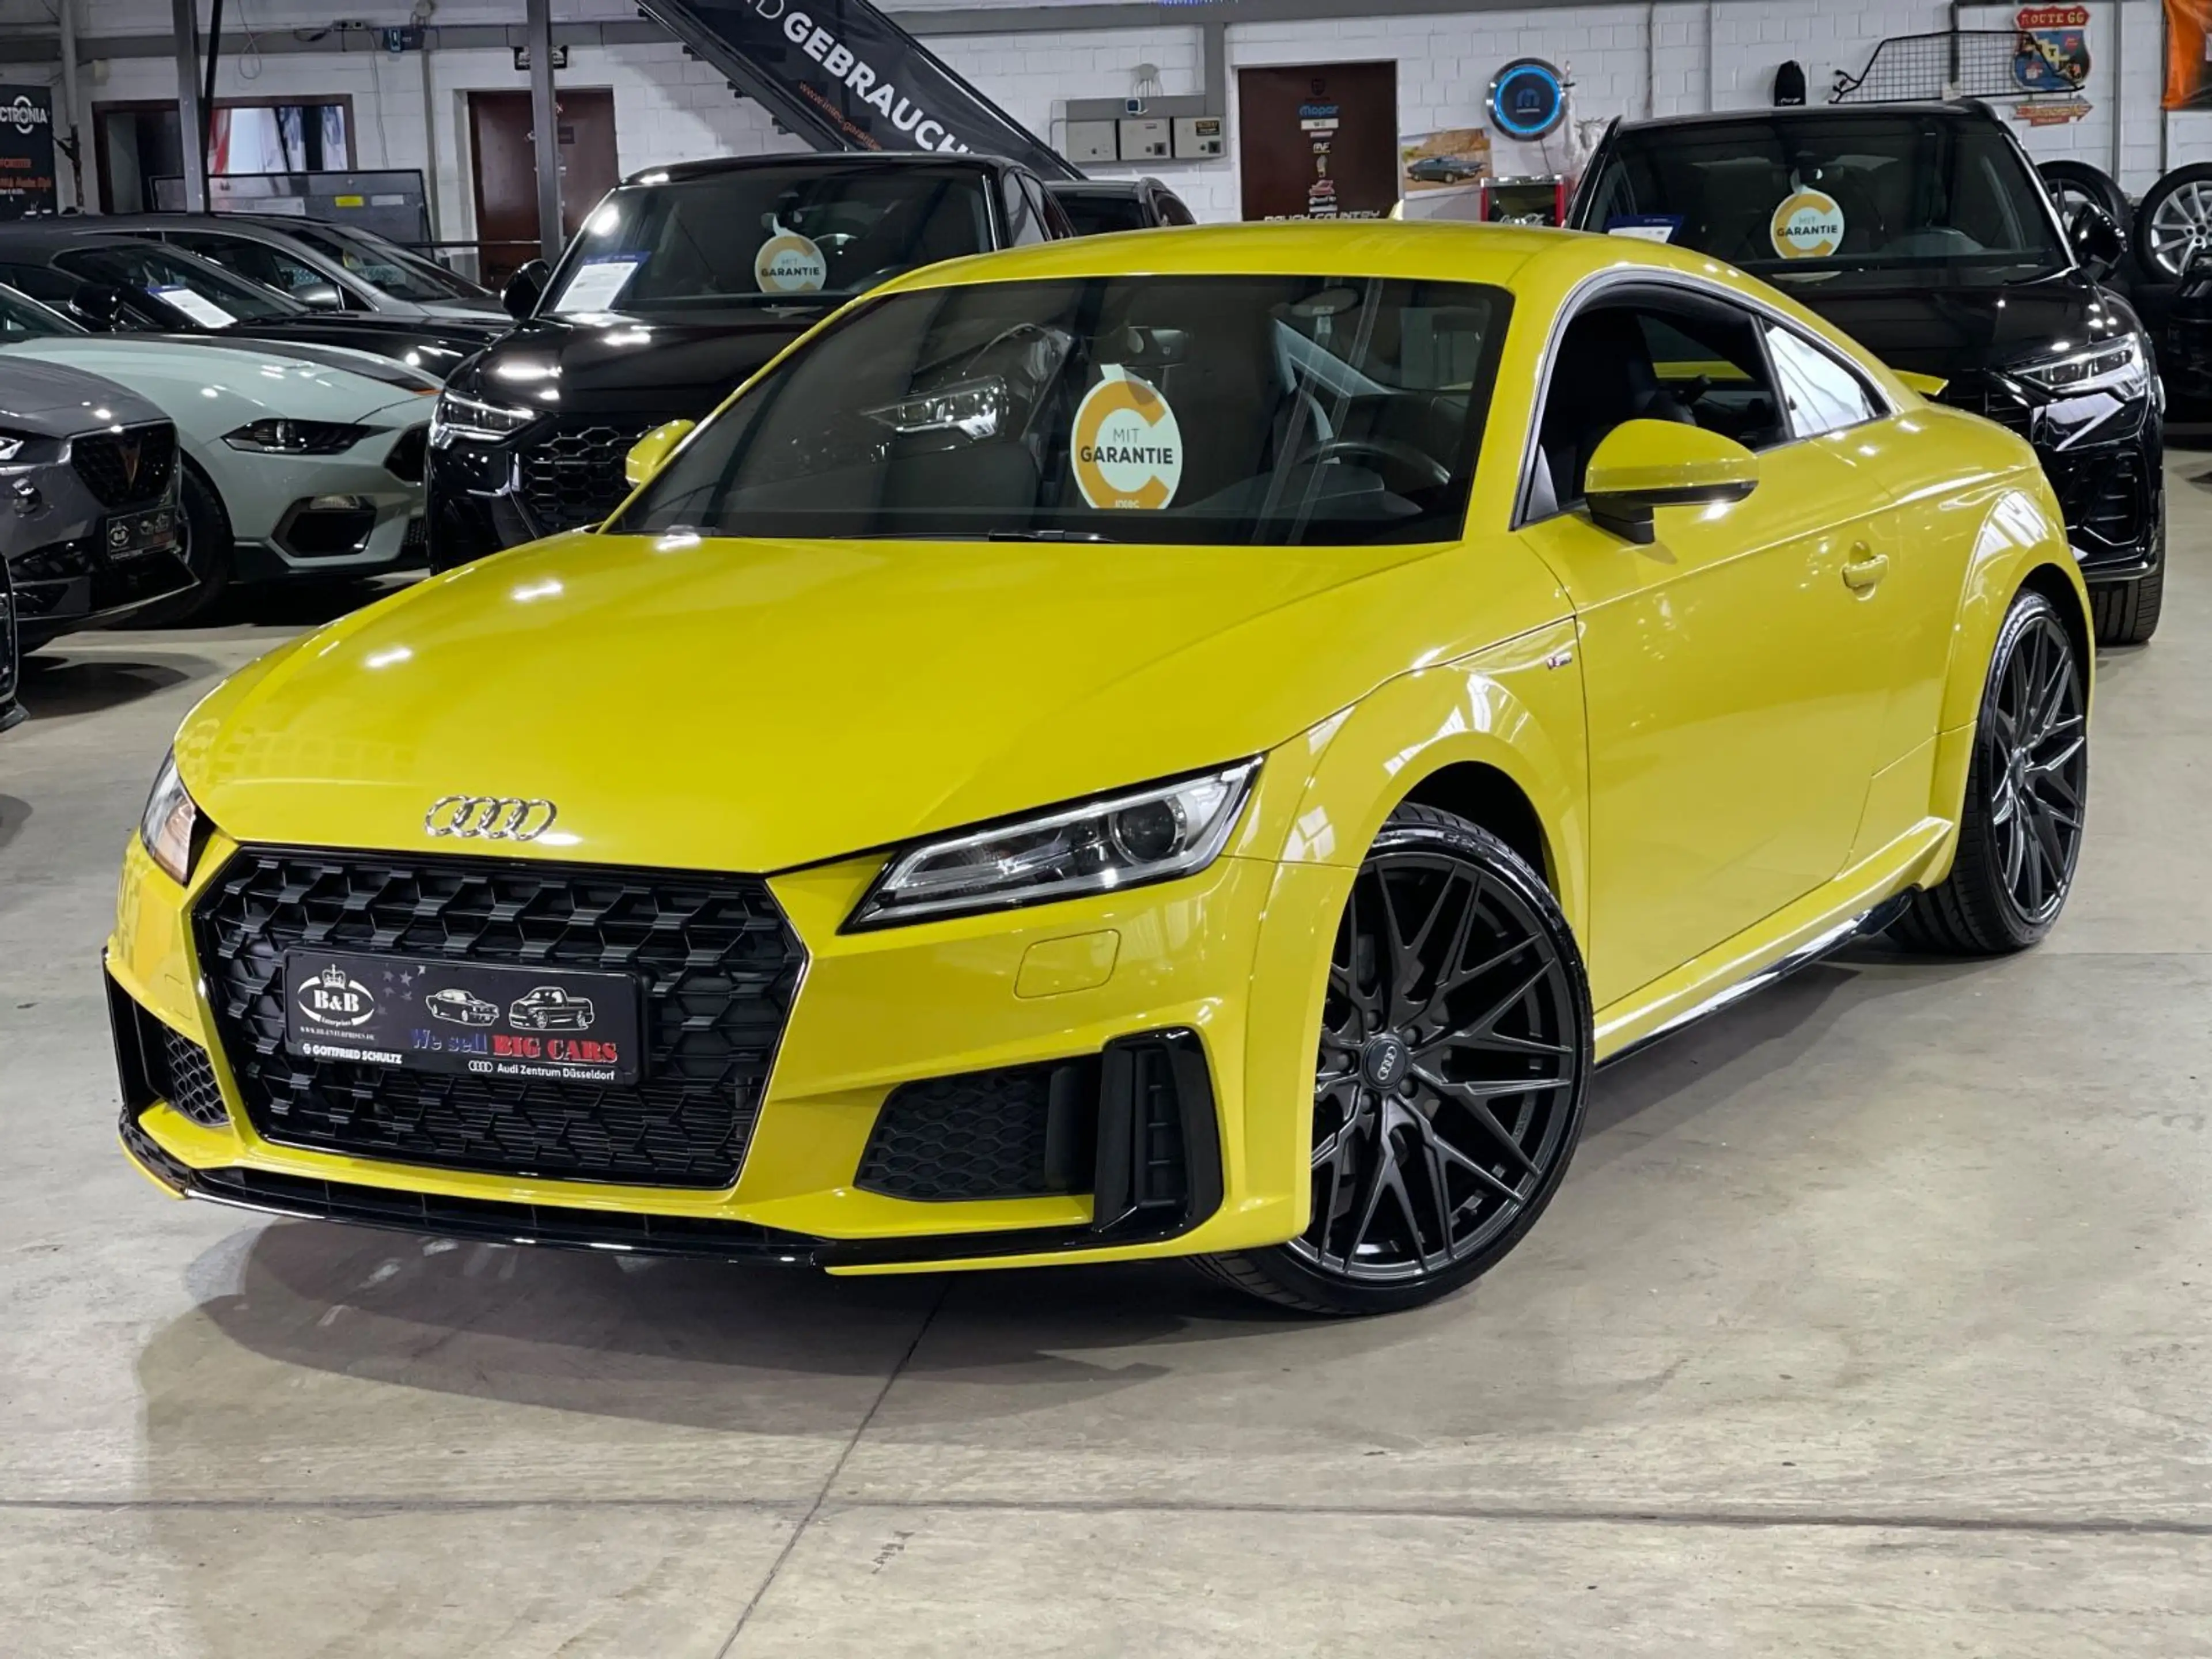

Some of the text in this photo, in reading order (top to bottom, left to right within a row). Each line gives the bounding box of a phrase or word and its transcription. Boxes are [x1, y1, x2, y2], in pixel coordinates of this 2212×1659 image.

[2021, 13, 2084, 25] ROUTE 66
[1777, 225, 1838, 237] GARANTIE
[761, 267, 820, 277] GARANTIE
[1112, 429, 1140, 443] MIT
[1080, 446, 1173, 464] GARANTIE
[314, 990, 359, 1012] B&B
[312, 1045, 402, 1065] GOTTFRIED SCHULTZ
[492, 1035, 541, 1058] BIG
[547, 1039, 618, 1064] CARS
[497, 1063, 615, 1080] Audi Zentrum Düsseldorf
